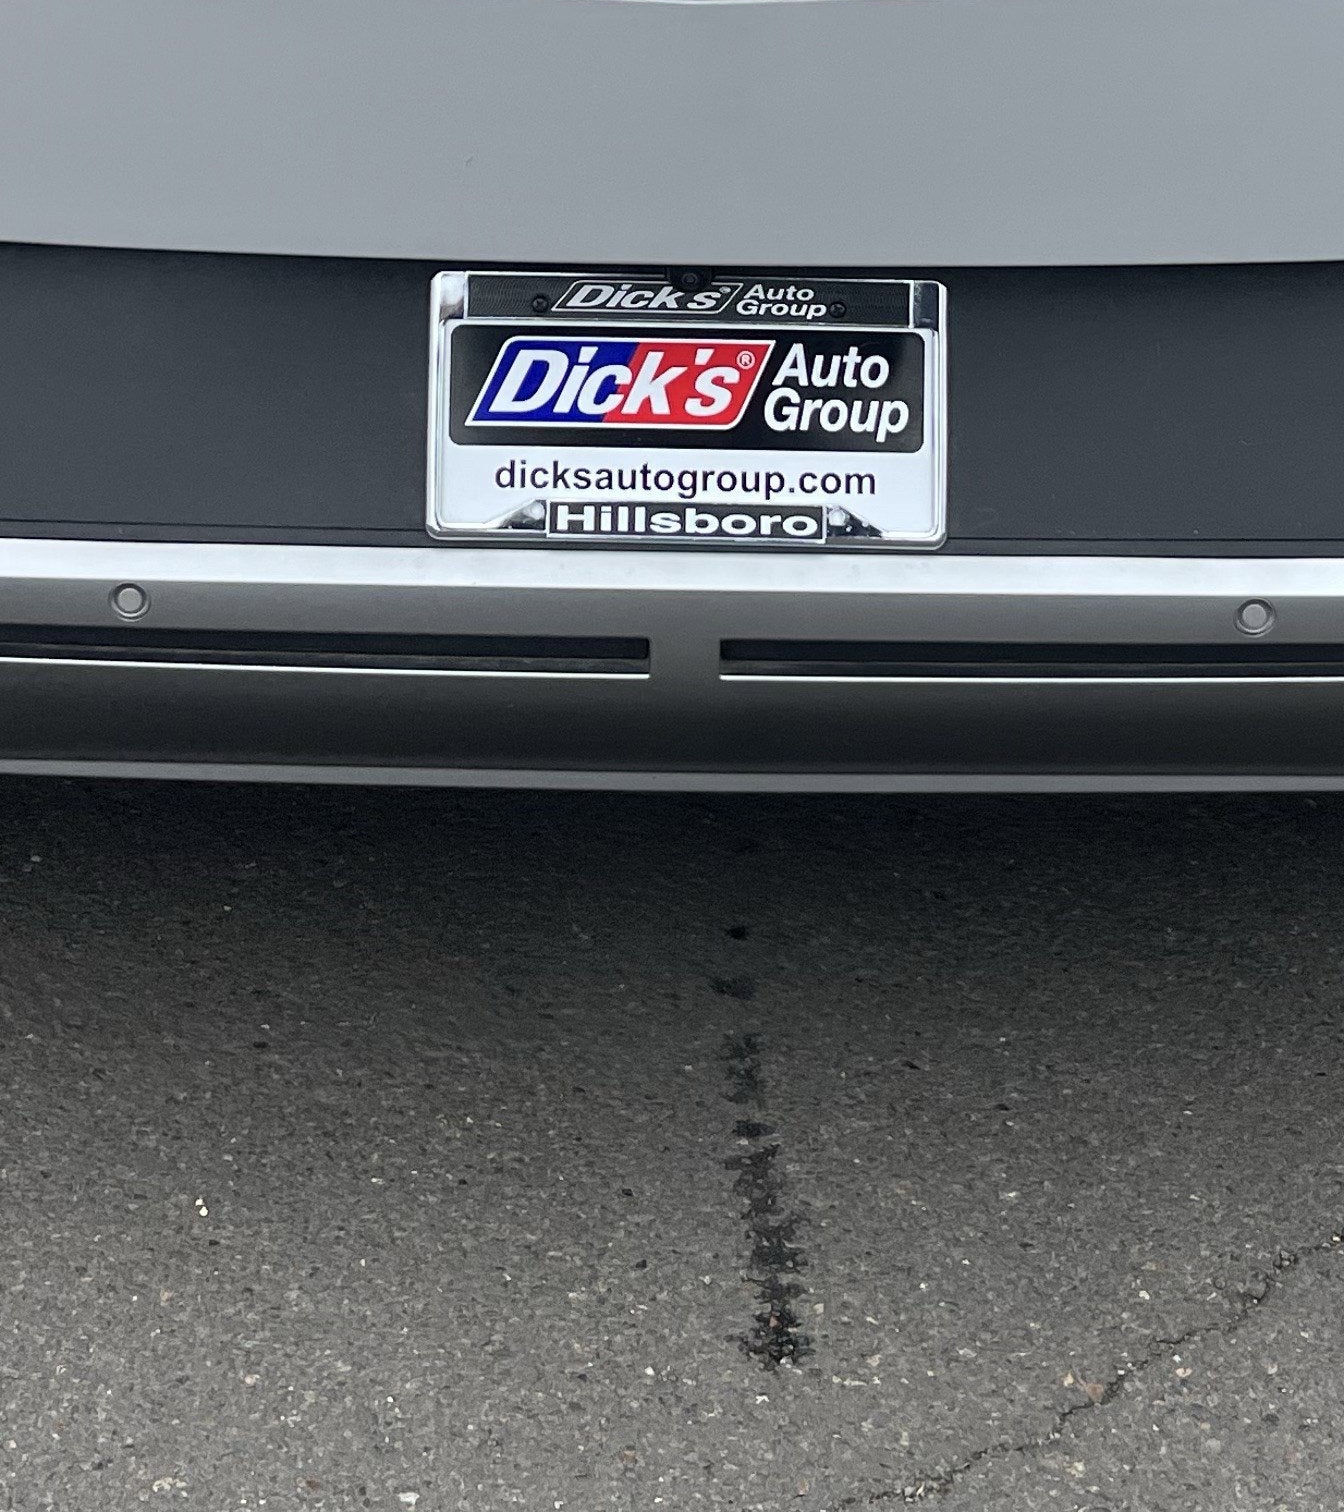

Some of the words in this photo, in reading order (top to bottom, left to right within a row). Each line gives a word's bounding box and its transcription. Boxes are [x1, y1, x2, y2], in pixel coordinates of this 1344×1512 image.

[565, 283, 721, 310] Dicks
[736, 299, 827, 320] Group
[746, 283, 815, 302] Auto
[771, 342, 890, 388] Auto
[763, 386, 910, 443] Group
[494, 459, 877, 501] dicksautogroup.com
[555, 504, 819, 538] Hillsboro
